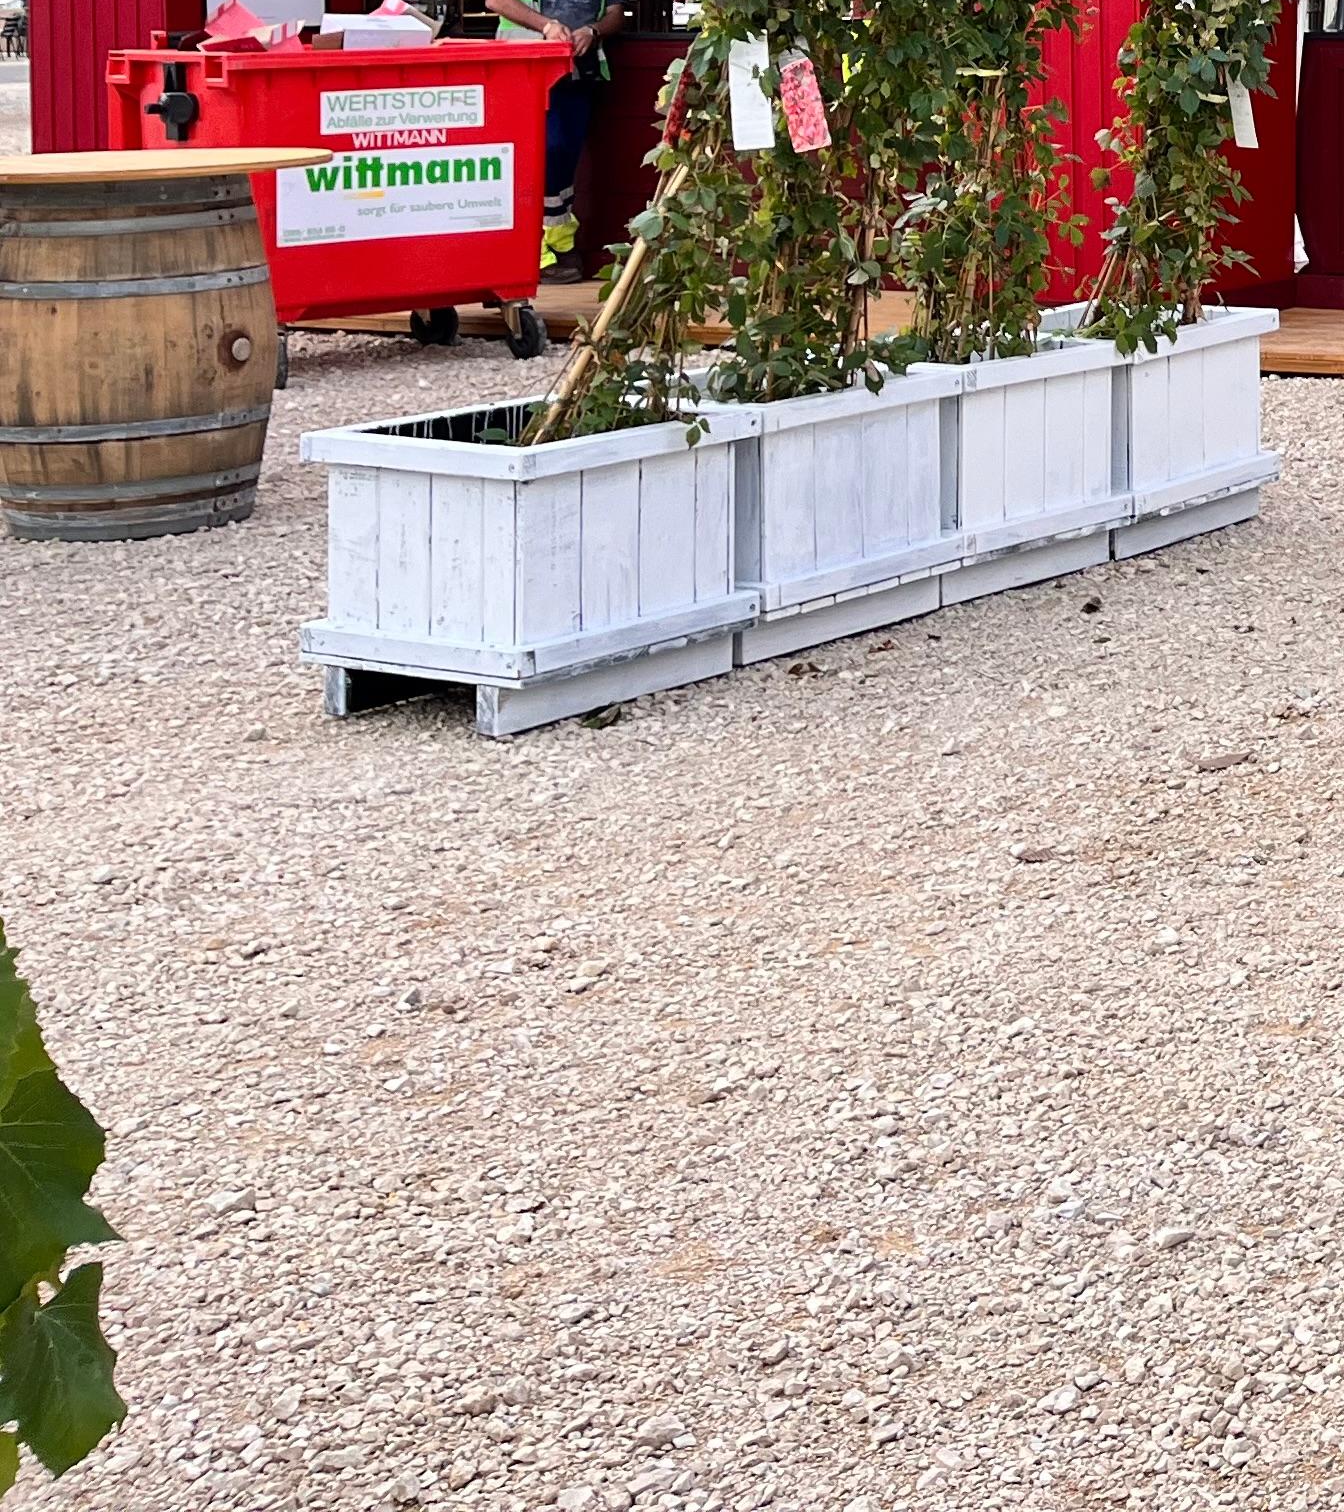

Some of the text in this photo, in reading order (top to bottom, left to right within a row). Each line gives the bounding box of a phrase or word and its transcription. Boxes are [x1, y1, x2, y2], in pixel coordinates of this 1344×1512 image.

[326, 88, 478, 113] WERTSTOFFE
[326, 111, 479, 129] Abfälle zur Verwertung
[351, 128, 448, 150] WITTMANN
[305, 155, 503, 193] wittmann
[357, 197, 503, 218] sorgt für saubere Umwelt
